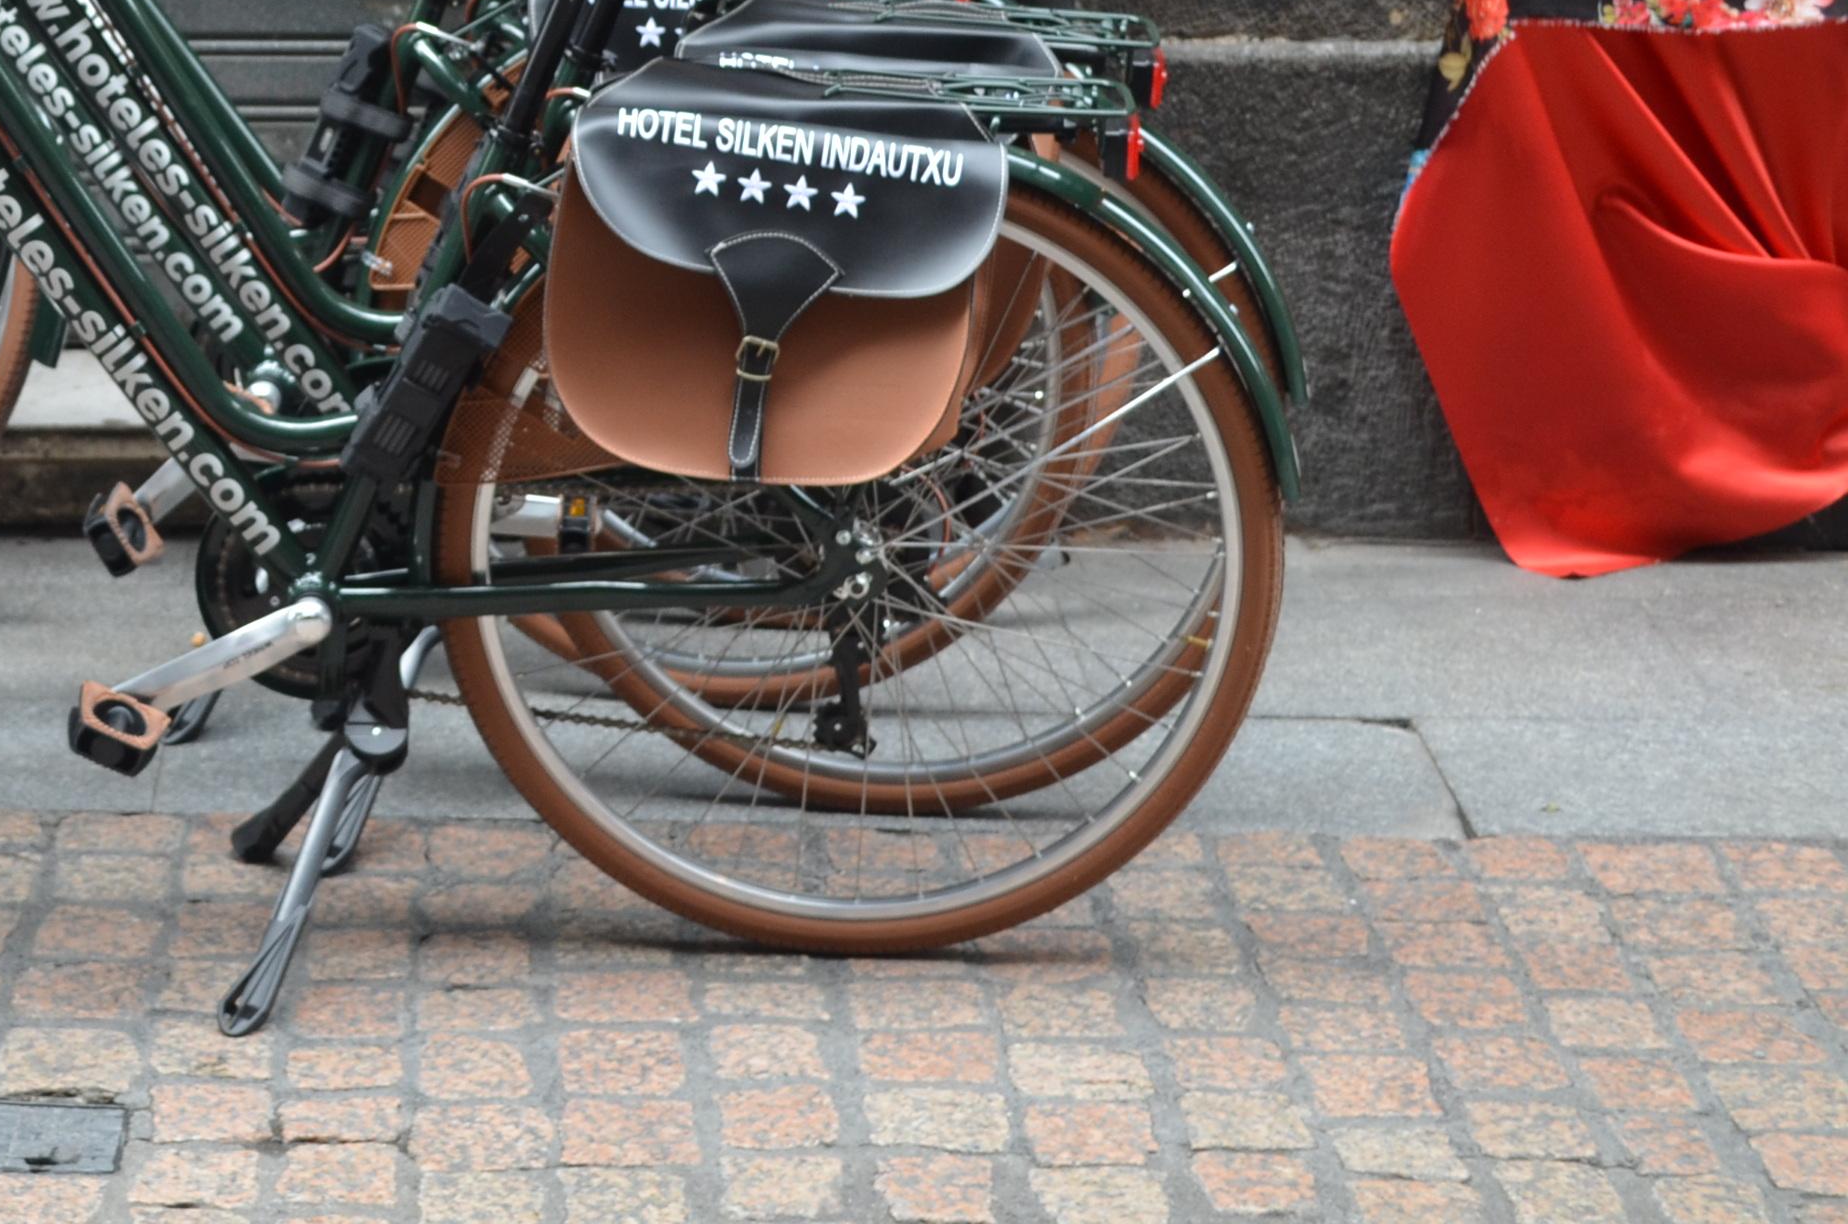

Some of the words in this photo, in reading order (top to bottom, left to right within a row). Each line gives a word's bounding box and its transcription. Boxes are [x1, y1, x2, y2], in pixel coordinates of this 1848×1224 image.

[617, 107, 707, 149] HOTEL
[715, 118, 816, 166] SILKEN
[821, 132, 965, 187] INDAUTXU
